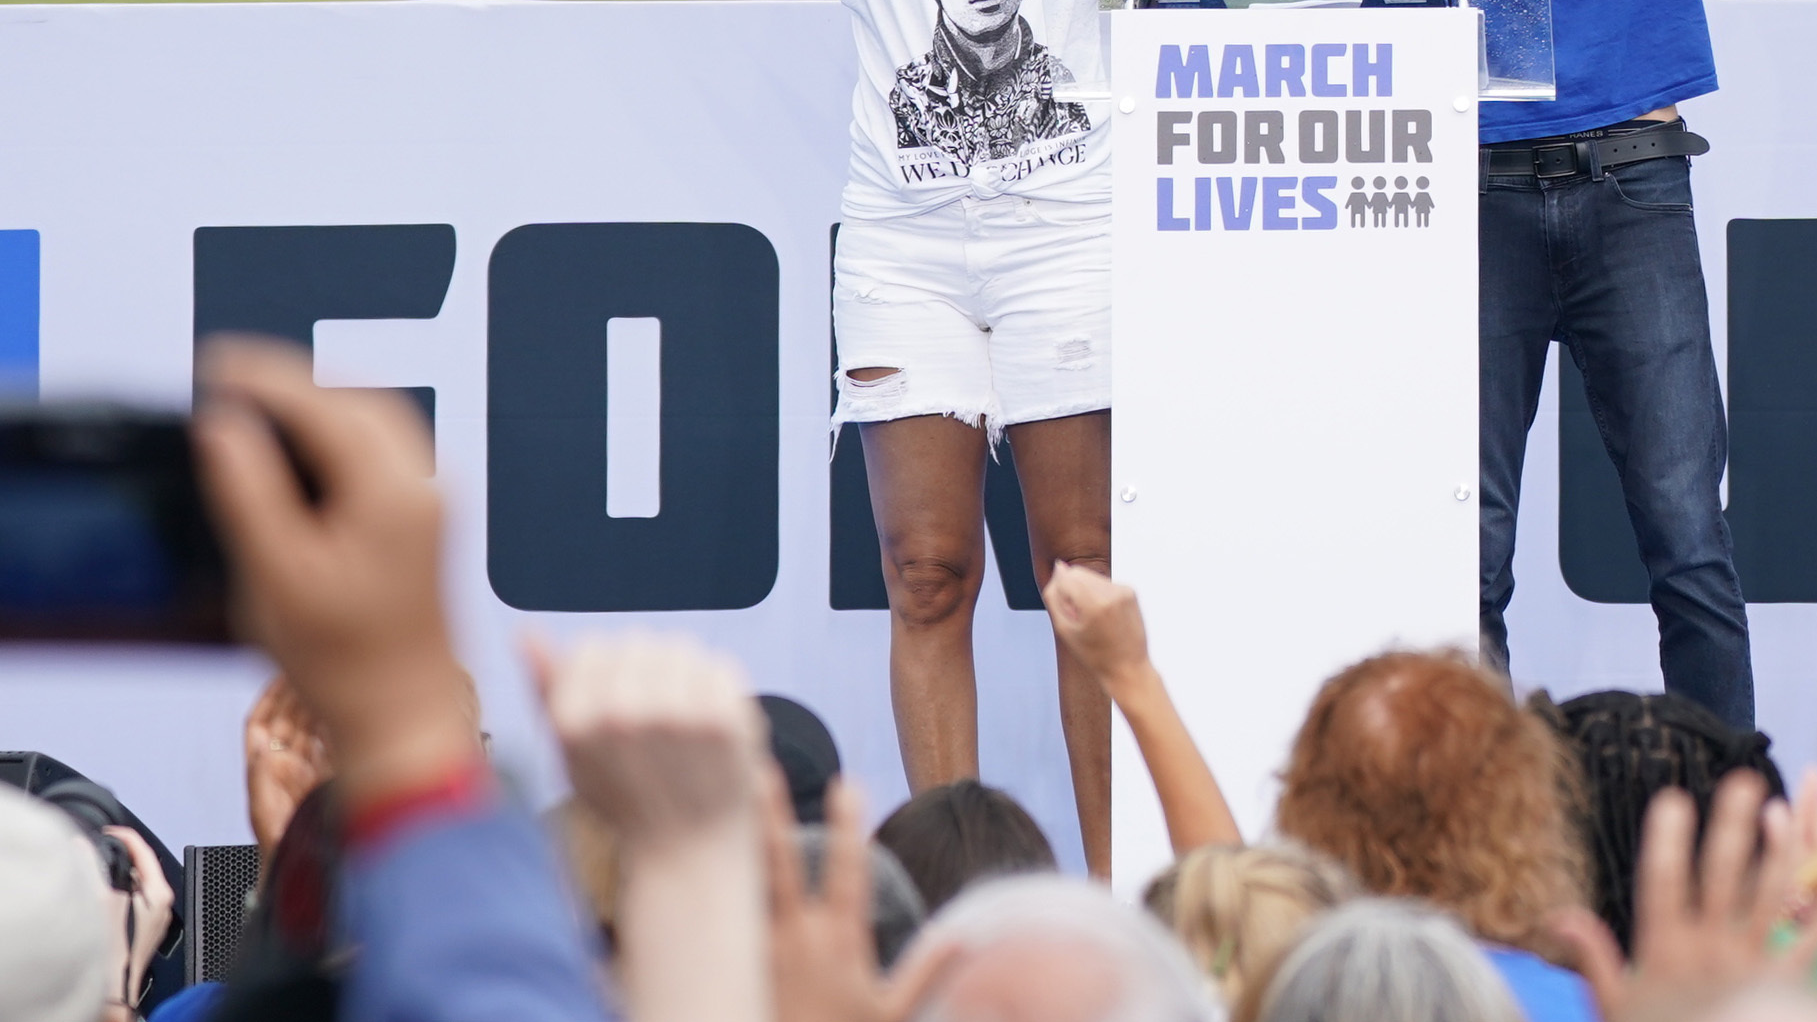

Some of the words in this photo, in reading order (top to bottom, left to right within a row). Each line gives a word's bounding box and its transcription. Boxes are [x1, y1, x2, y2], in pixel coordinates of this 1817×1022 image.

[1155, 43, 1393, 99] MARCH
[914, 151, 940, 161] LOVE
[1157, 110, 1286, 165] FOR
[1298, 109, 1433, 164] OUR
[900, 161, 946, 184] WE
[1157, 176, 1338, 231] LIVES
